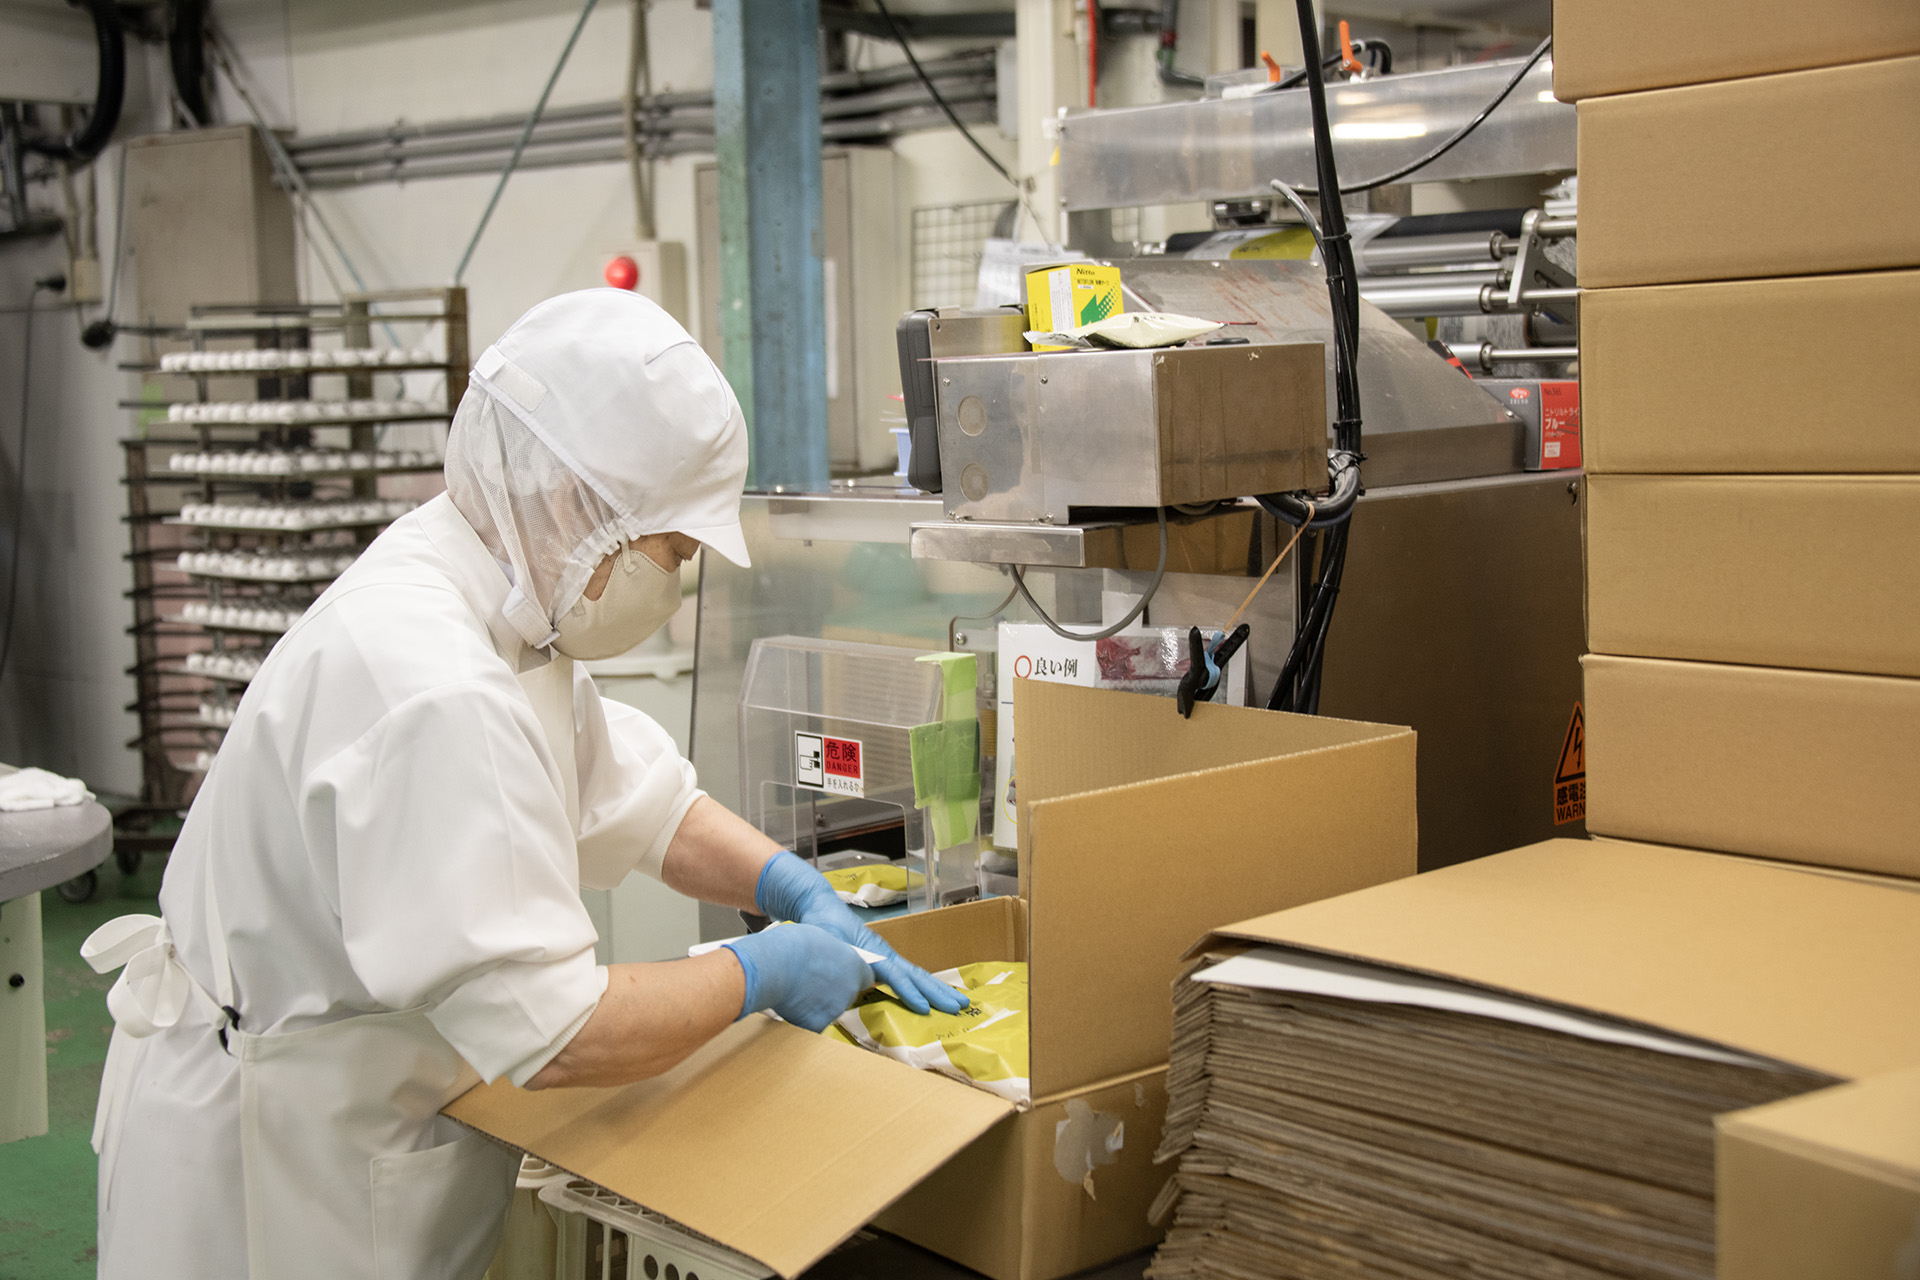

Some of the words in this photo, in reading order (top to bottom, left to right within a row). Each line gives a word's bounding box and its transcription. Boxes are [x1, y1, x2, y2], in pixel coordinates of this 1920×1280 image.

[1076, 268, 1096, 276] Nitto
[1544, 418, 1566, 430] ブルー
[1034, 656, 1078, 678] 良い例
[825, 740, 857, 763] 危険
[826, 761, 859, 774] DANGER
